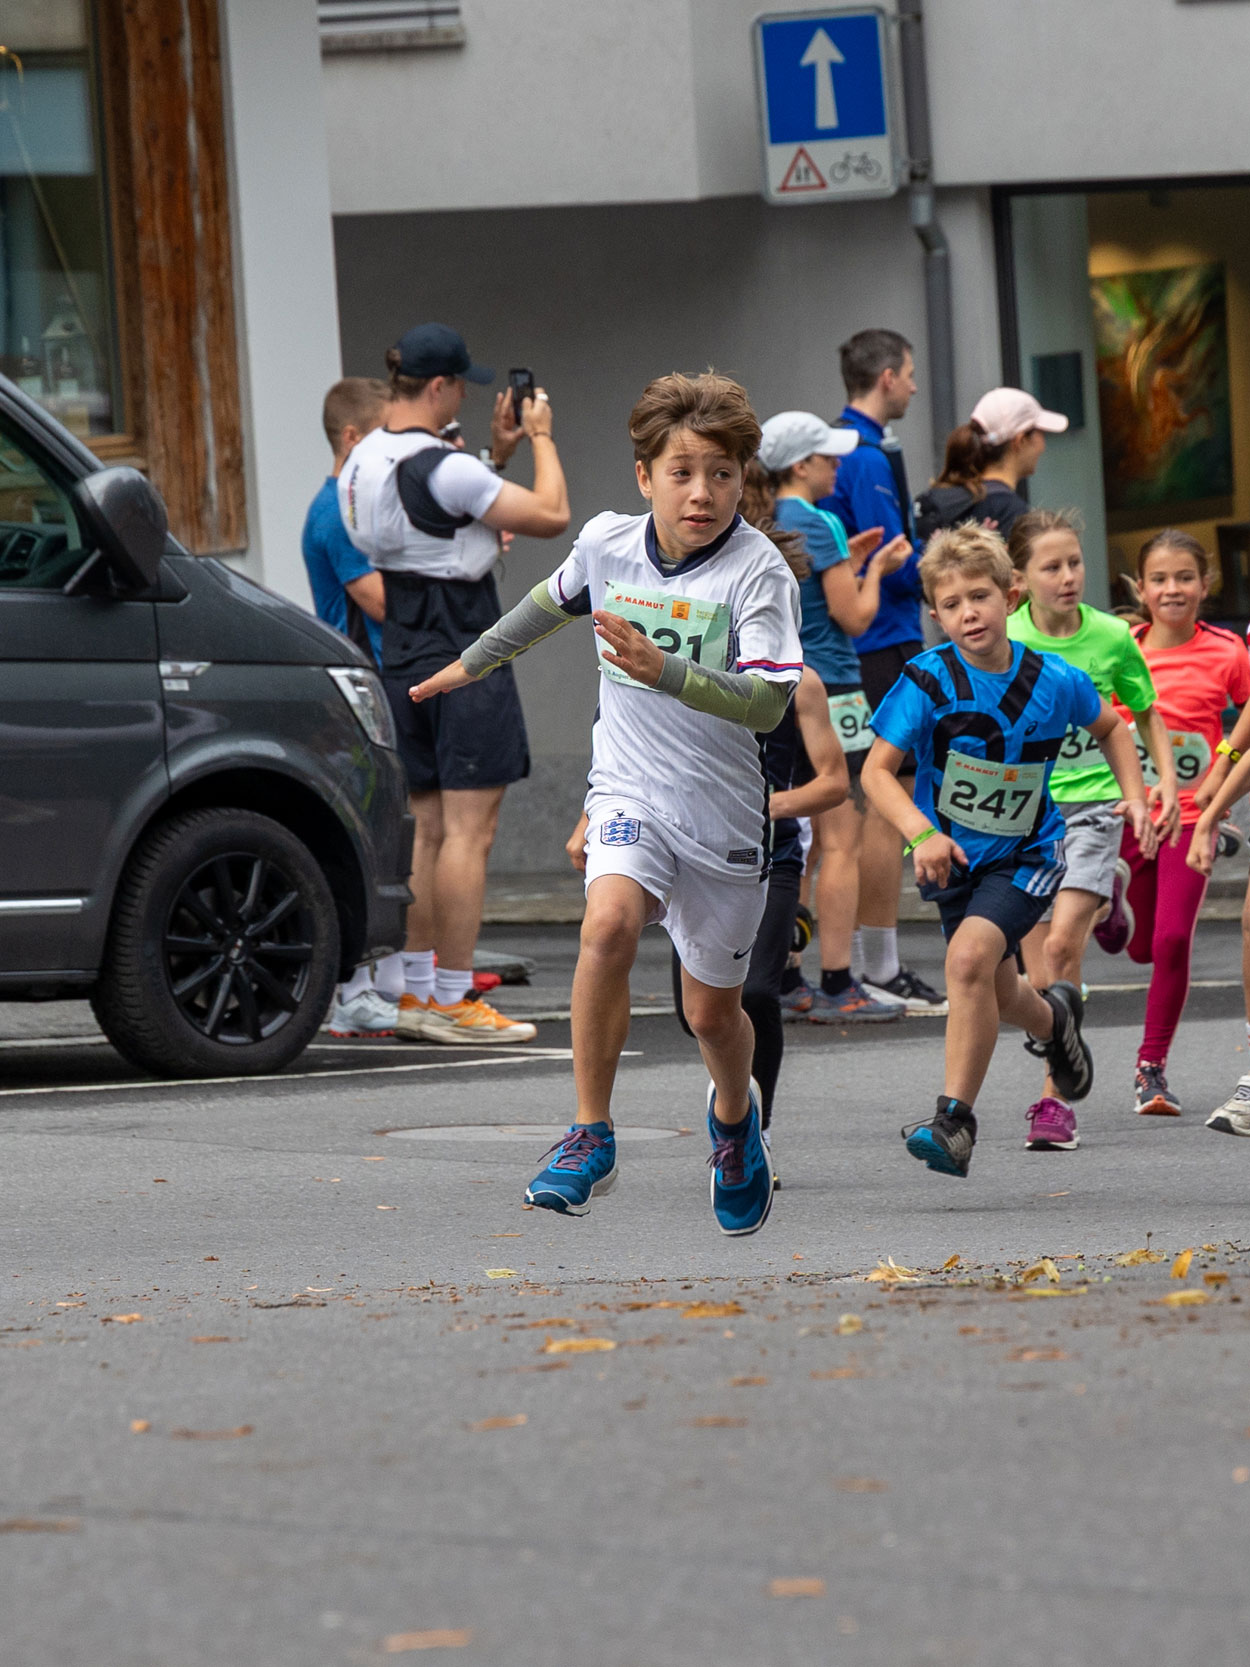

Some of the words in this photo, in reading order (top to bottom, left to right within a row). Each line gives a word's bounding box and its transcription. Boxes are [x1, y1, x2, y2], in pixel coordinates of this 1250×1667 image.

[624, 596, 665, 611] MAMMUT
[616, 620, 703, 665] 21
[949, 779, 1034, 821] 247
